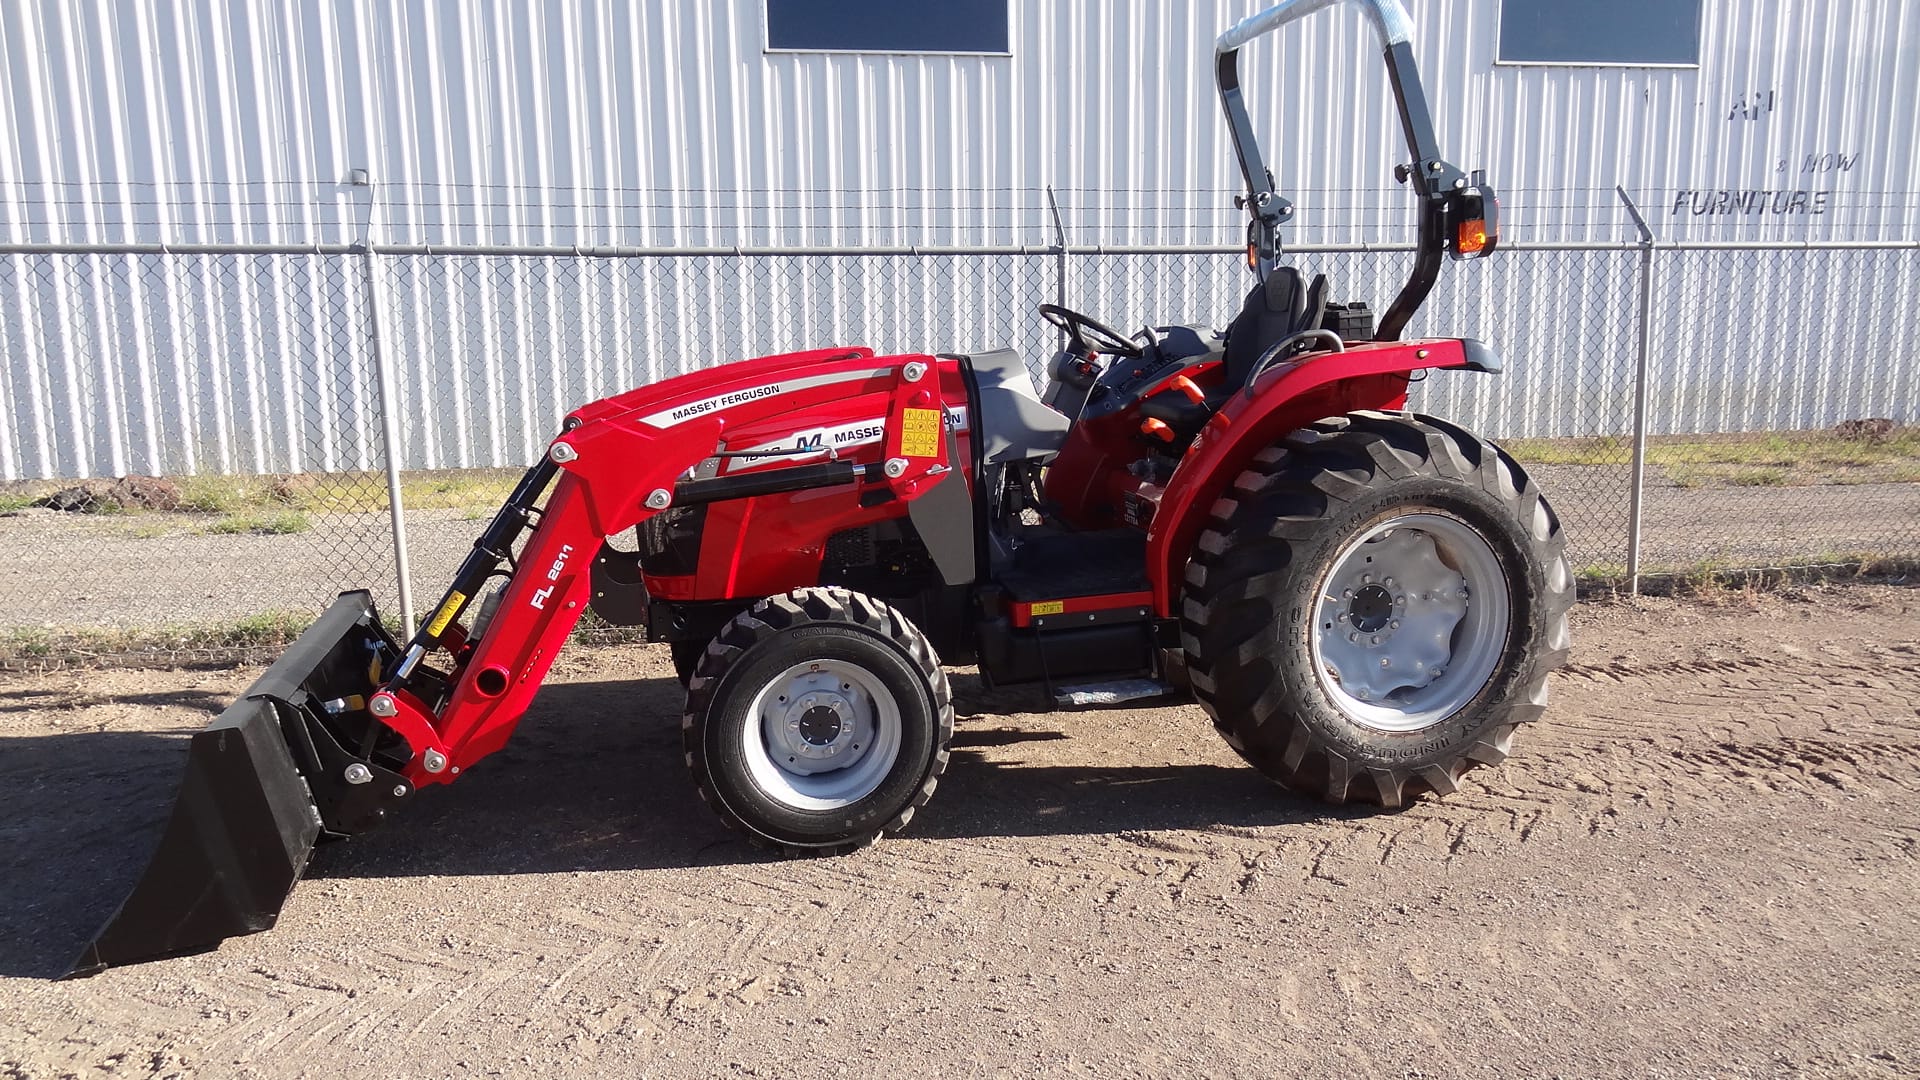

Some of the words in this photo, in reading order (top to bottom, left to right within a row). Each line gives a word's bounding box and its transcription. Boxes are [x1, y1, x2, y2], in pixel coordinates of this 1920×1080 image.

[1671, 190, 1829, 216] FURNITURE
[672, 400, 718, 420] MASSEY
[721, 384, 780, 406] FERGUSON
[834, 426, 884, 443] MASSE
[530, 585, 555, 610] FL
[547, 544, 574, 581] 2611
